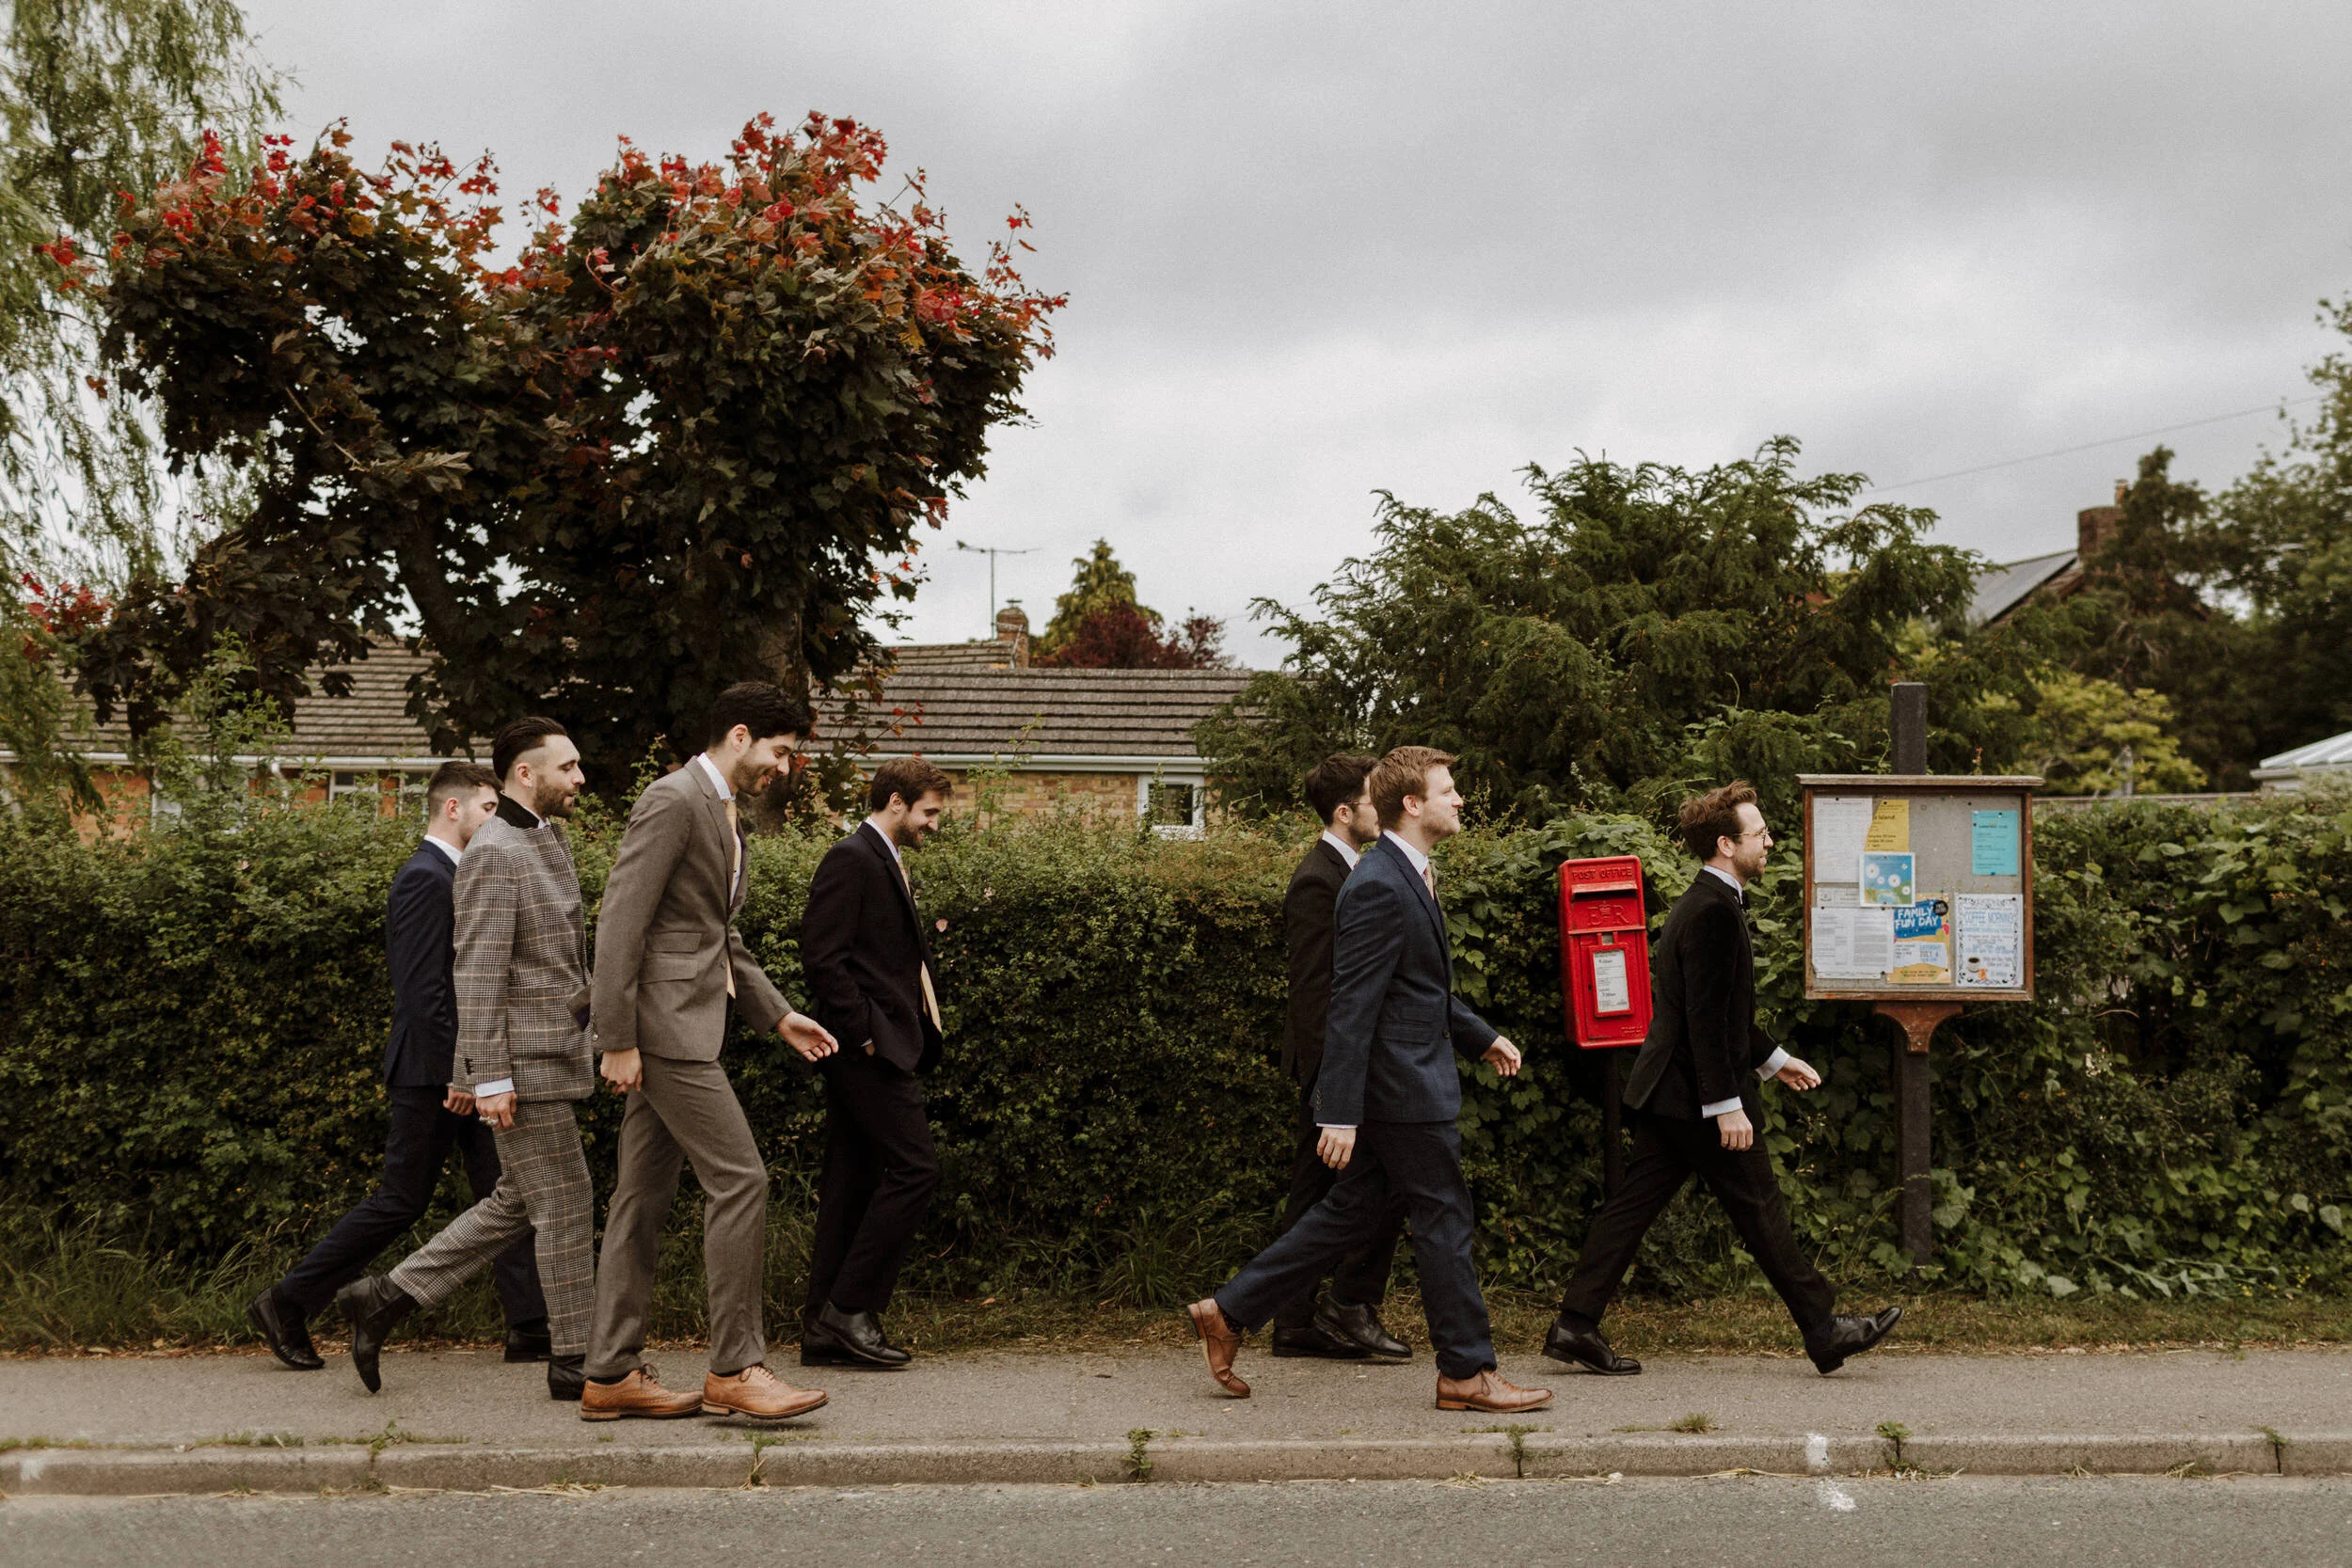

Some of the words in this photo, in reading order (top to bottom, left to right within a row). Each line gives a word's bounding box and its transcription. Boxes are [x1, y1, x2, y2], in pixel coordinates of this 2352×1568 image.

[1572, 868, 1597, 880] POST
[1600, 866, 1632, 879] OFFICE
[1898, 906, 1933, 920] FAMILY
[1894, 918, 1915, 929] FUN
[1918, 915, 1939, 927] DAY
